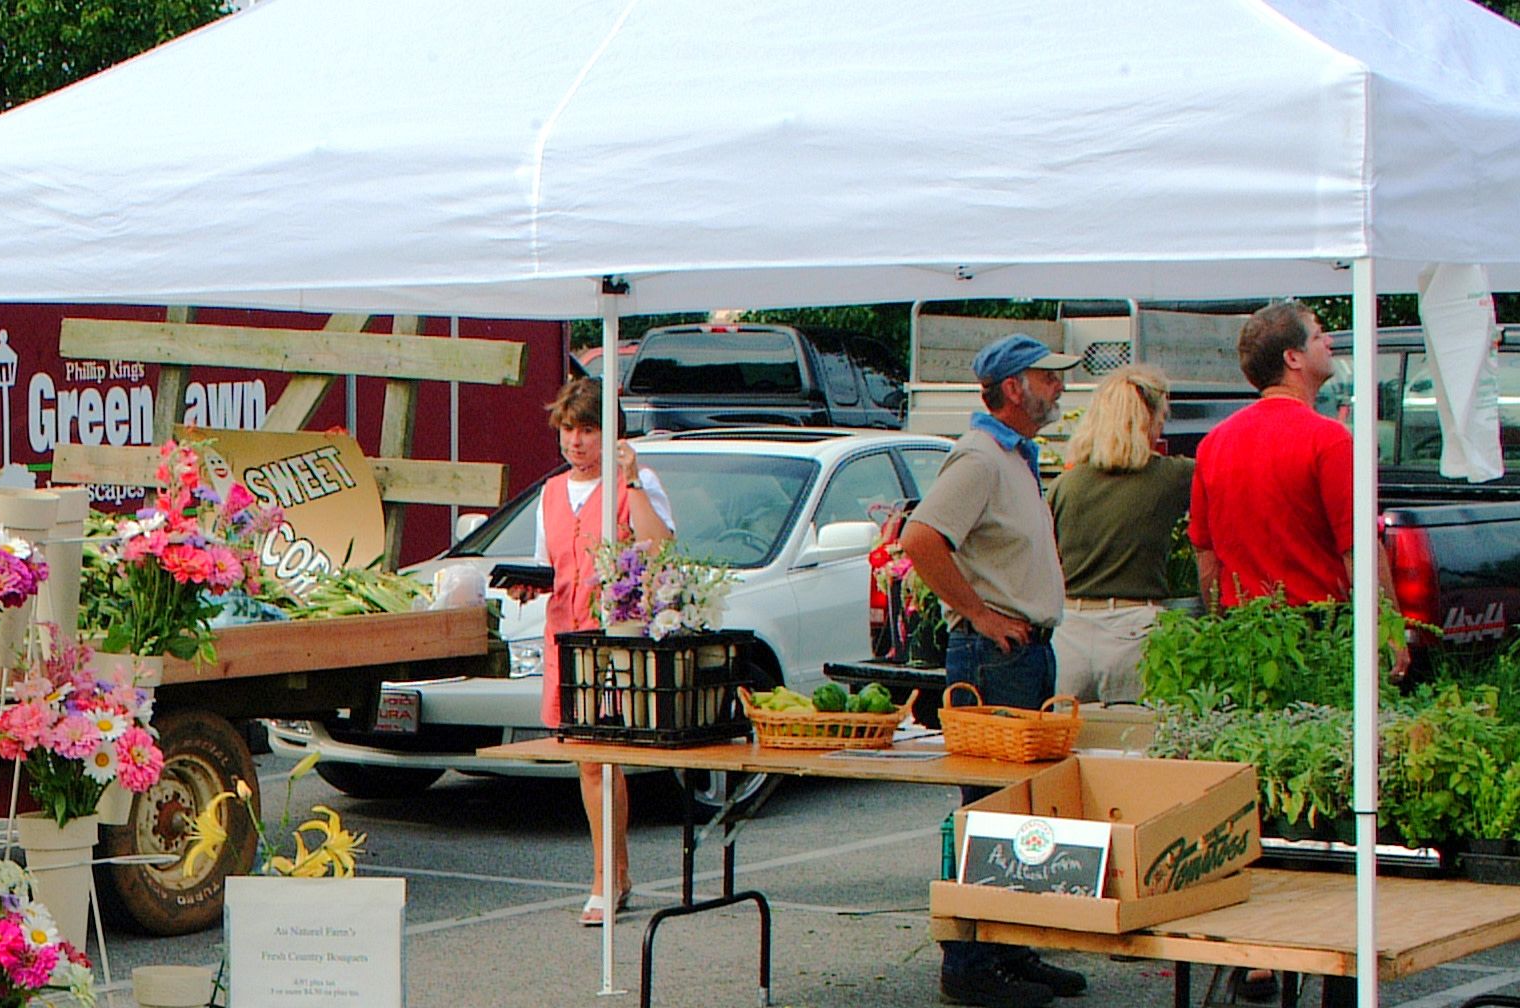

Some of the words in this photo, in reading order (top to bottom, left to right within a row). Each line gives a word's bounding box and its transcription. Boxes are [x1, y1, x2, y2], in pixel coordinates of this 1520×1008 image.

[65, 361, 106, 383] Phillip
[28, 372, 153, 453] Green
[184, 379, 267, 431] awn
[244, 445, 356, 510] SWEET
